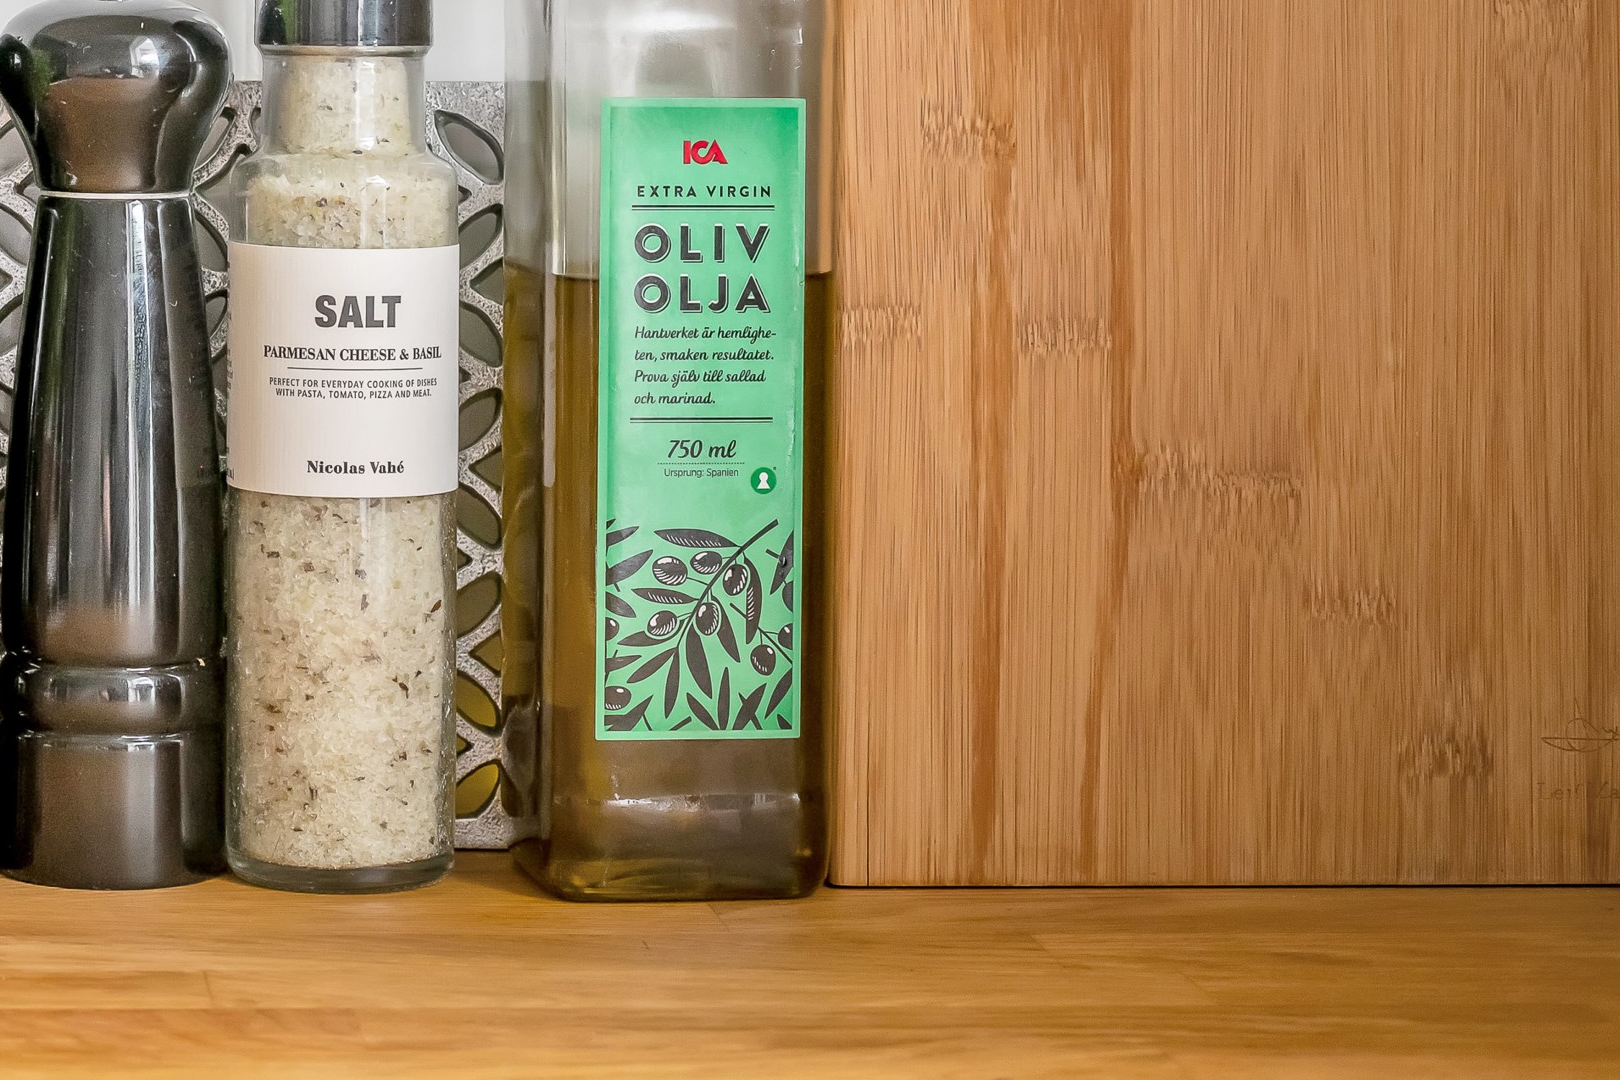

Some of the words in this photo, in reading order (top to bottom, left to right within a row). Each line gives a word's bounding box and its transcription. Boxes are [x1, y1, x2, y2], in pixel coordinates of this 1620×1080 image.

[683, 139, 728, 164] ICA
[637, 186, 697, 198] EXTRA
[706, 186, 771, 198] VIRGIN
[634, 222, 771, 264] OLIV
[634, 272, 771, 314] OLJA
[314, 294, 402, 329] SALT
[634, 326, 699, 339] Hantverket
[702, 326, 716, 339] är
[717, 325, 777, 344] hemlighe-
[263, 345, 337, 361] PARMESAN
[339, 348, 396, 361] CHEESE
[399, 348, 409, 361] &
[413, 346, 442, 360] BASIL
[634, 350, 658, 362] ten,
[660, 348, 708, 361] smaken
[712, 348, 775, 361] resultatet.
[269, 376, 300, 387] PERFECT
[302, 379, 319, 388] FOR
[321, 379, 364, 389] EVERYDAY
[366, 379, 404, 389] COOKING
[405, 379, 415, 388] OF
[416, 377, 438, 387] DISHES
[634, 370, 669, 383] Prova
[671, 370, 700, 388] själv
[702, 370, 724, 383] till
[725, 370, 766, 383] sallad
[275, 388, 295, 397] WITH
[297, 389, 326, 399] PASTA,
[329, 390, 367, 400] TOMATO,
[369, 389, 393, 398] PIZZA
[395, 389, 411, 398] AND
[412, 388, 432, 397] MEAT.
[634, 392, 656, 404] och
[658, 392, 716, 404] marinad.
[667, 439, 703, 459] 750
[708, 439, 737, 458] ml
[306, 460, 365, 474] Nicolas
[369, 460, 405, 474] Vahé
[664, 468, 705, 478] Ursprung:
[706, 468, 739, 478] Spanien
